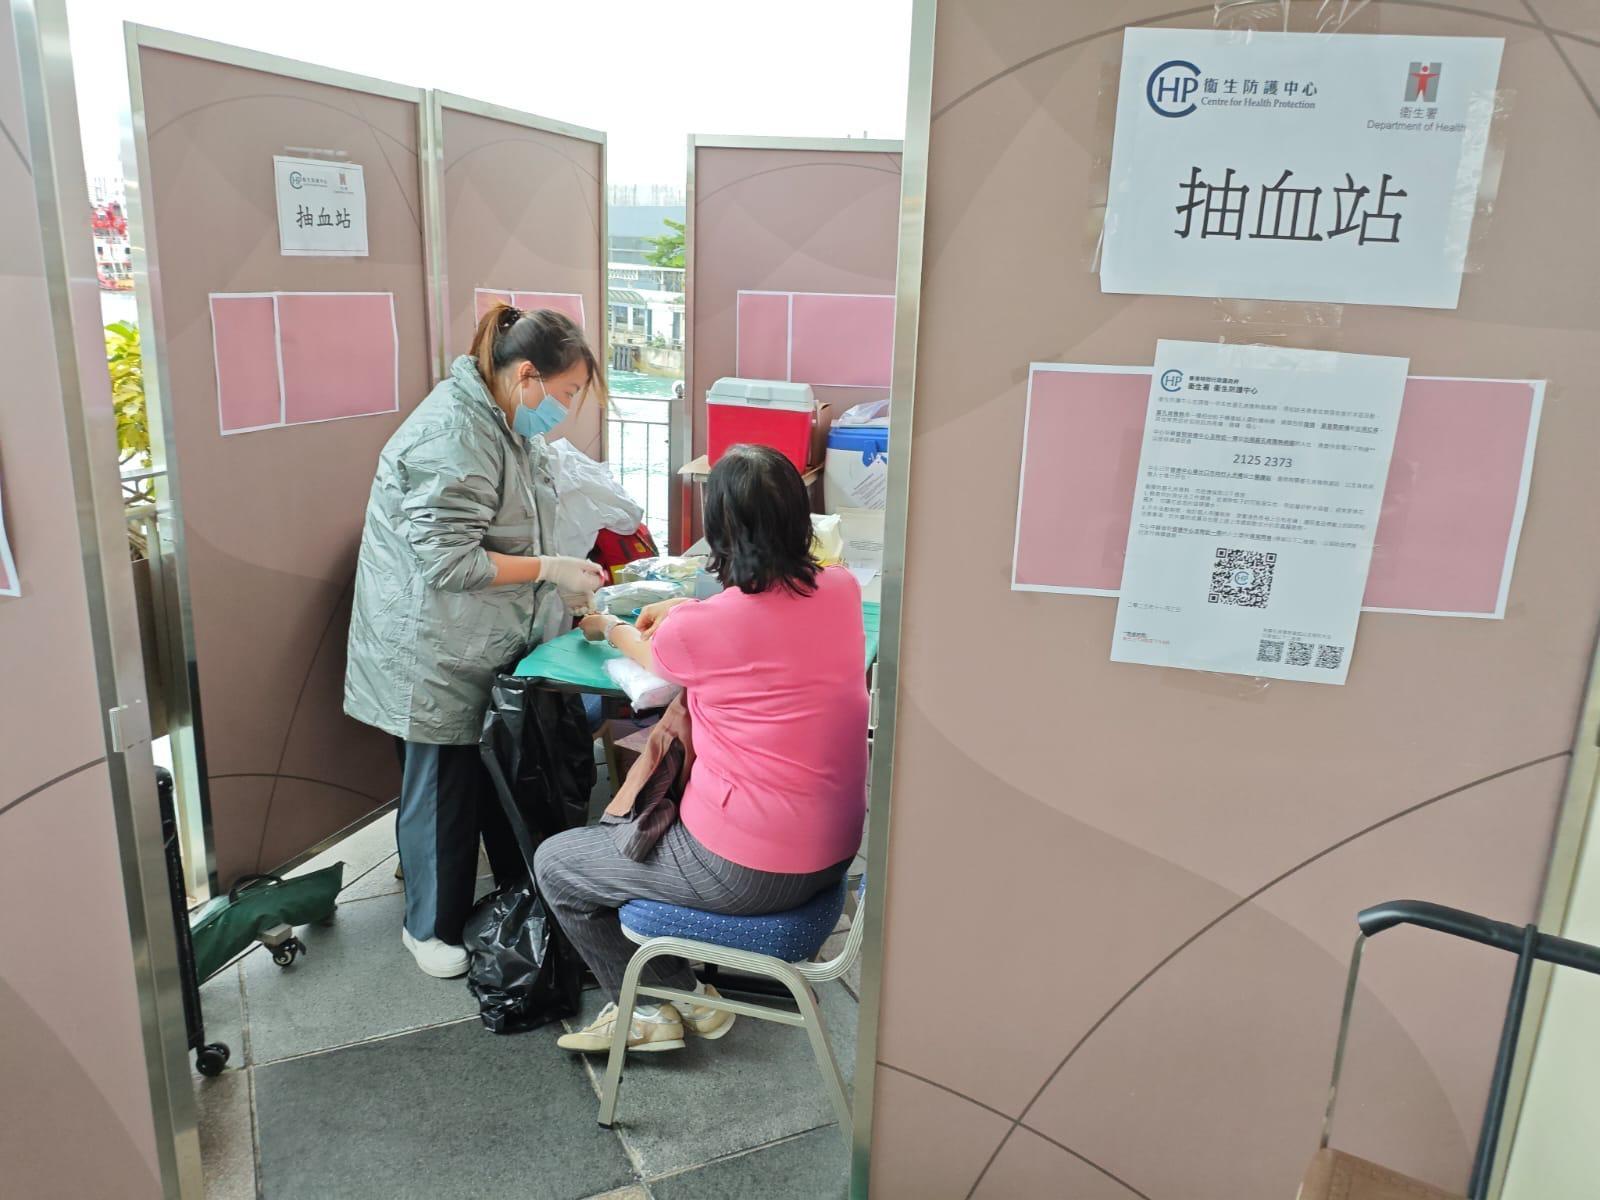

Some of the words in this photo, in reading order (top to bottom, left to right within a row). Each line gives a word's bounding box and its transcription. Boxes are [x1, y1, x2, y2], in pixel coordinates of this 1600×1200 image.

[1147, 60, 1200, 118] CHP
[1201, 97, 1228, 107] Centre
[1229, 97, 1242, 107] for
[1244, 98, 1271, 108] Health
[1273, 98, 1316, 109] Protection
[1367, 120, 1422, 131] Department
[1424, 122, 1434, 131] of
[1435, 123, 1466, 132] Health
[1174, 166, 1407, 246] 抽血站
[296, 205, 351, 229] 抽血站
[1233, 454, 1261, 466] 2125
[1265, 456, 1293, 468] 2373
